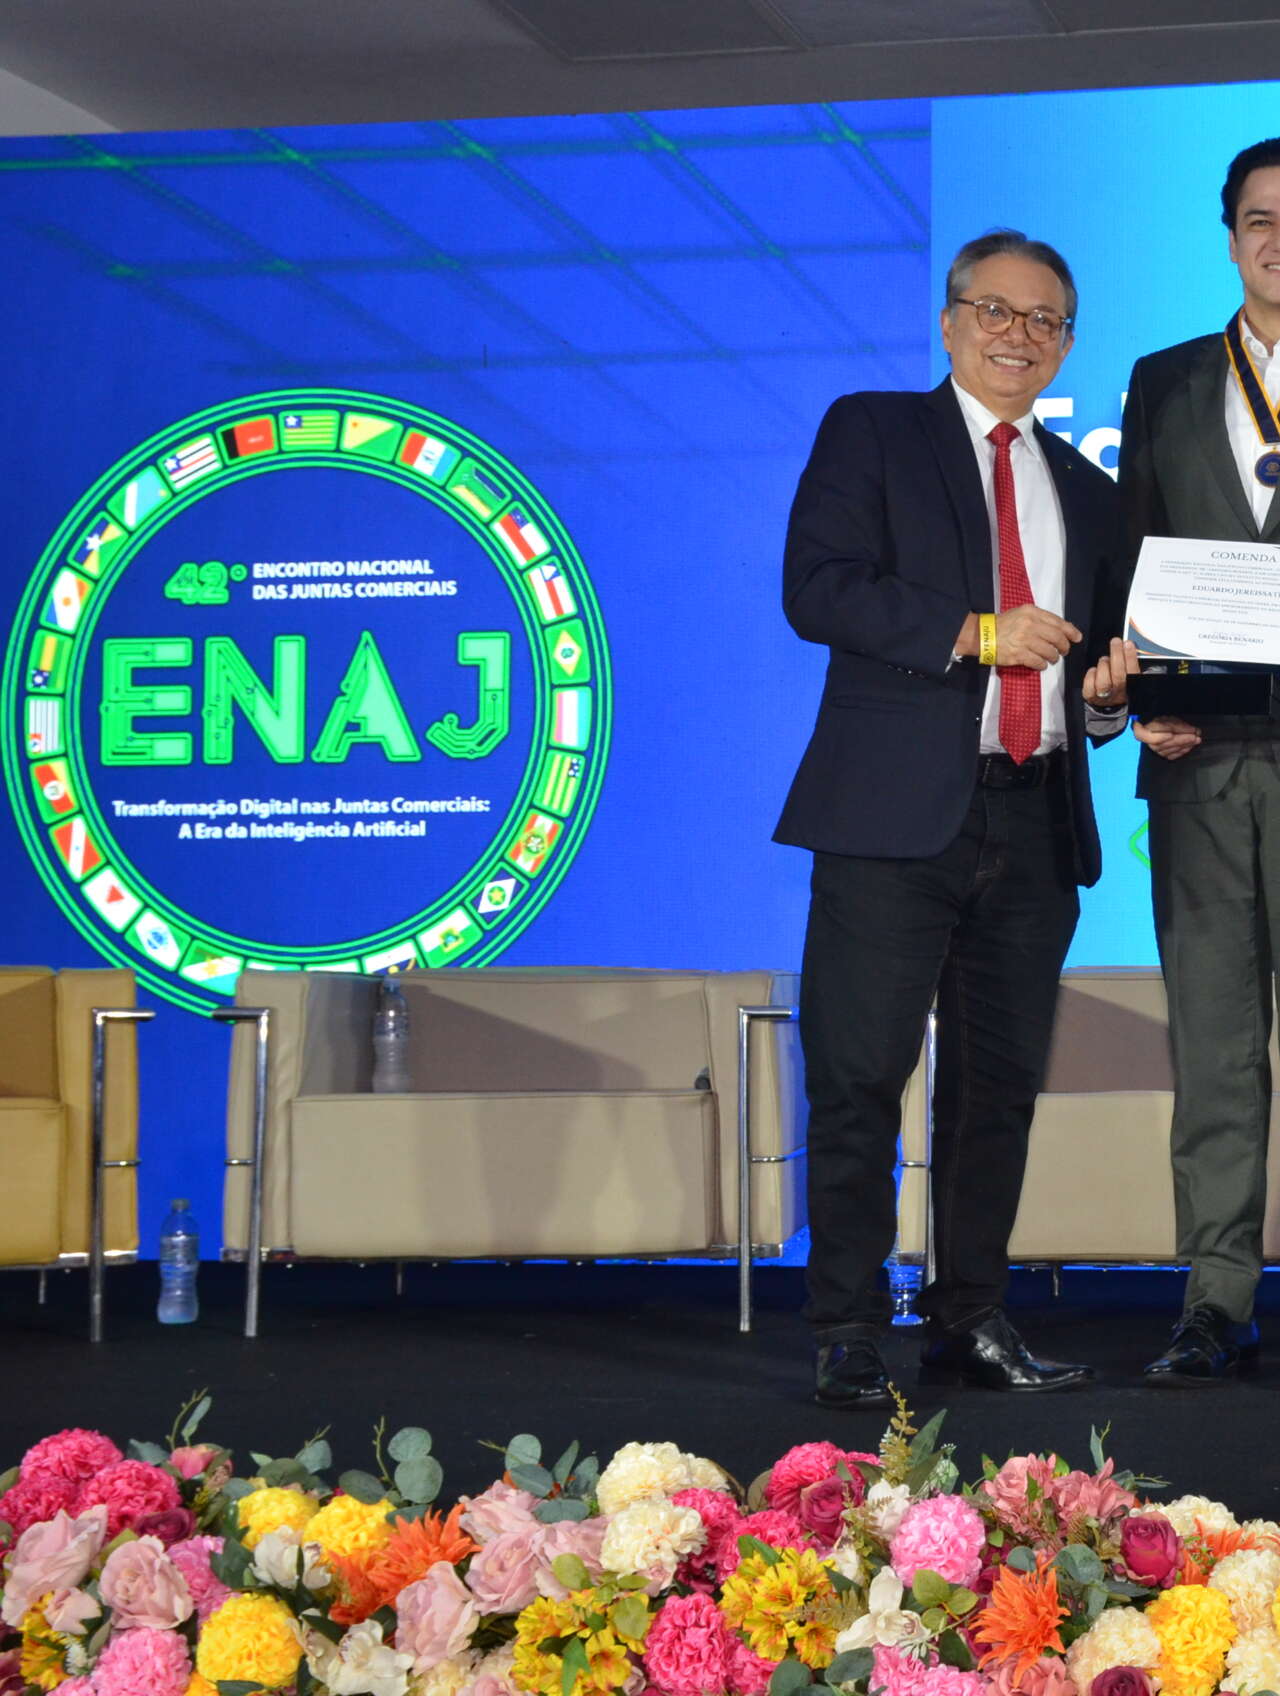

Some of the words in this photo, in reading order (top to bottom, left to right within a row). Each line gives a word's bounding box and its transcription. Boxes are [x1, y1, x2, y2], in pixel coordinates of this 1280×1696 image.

[1210, 551, 1277, 562] COMENDA
[253, 561, 345, 579] ENCONTRO
[346, 560, 434, 577] NACIONAL
[252, 583, 288, 600] DAS
[289, 582, 353, 599] JUNTAS
[355, 581, 457, 598] COMERCIAIS
[100, 630, 511, 766] ENAJ
[112, 799, 239, 820] Transformação
[240, 798, 298, 819] Digital
[300, 801, 330, 815] nas
[332, 798, 389, 814] Juntas
[391, 796, 490, 814] Comerciais:
[178, 823, 193, 839] A
[195, 823, 223, 839] Era
[224, 822, 248, 839] da
[250, 821, 350, 842] Inteligência
[352, 820, 426, 837] Artificial
